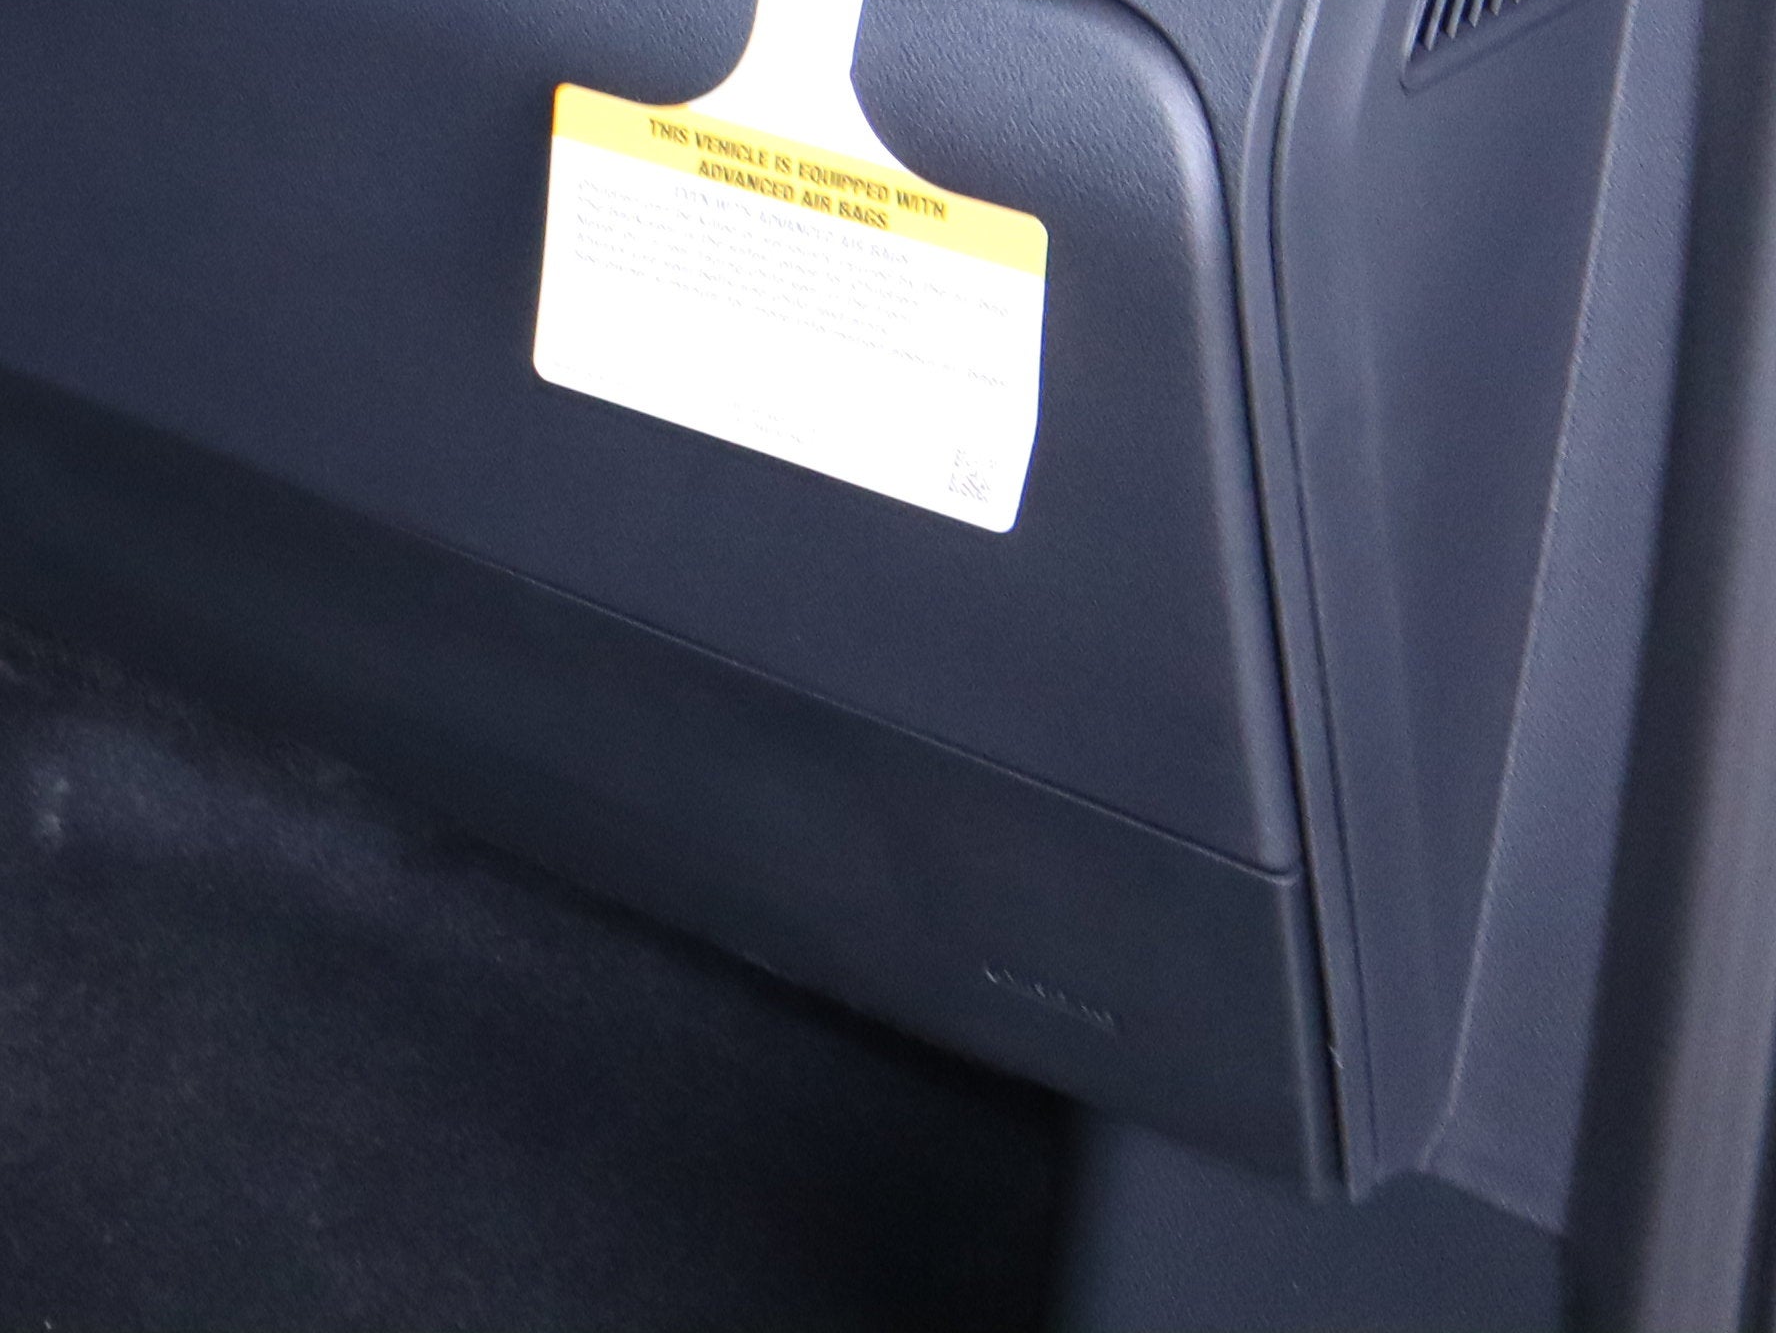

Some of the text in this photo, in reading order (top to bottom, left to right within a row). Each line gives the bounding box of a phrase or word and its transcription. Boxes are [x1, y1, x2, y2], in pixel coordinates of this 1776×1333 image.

[649, 118, 946, 220] THIS VEHICLE IS EQUIPPED WITH
[698, 159, 795, 202] ADVANCED
[801, 190, 832, 213] AIR
[838, 200, 889, 230] BAGS
